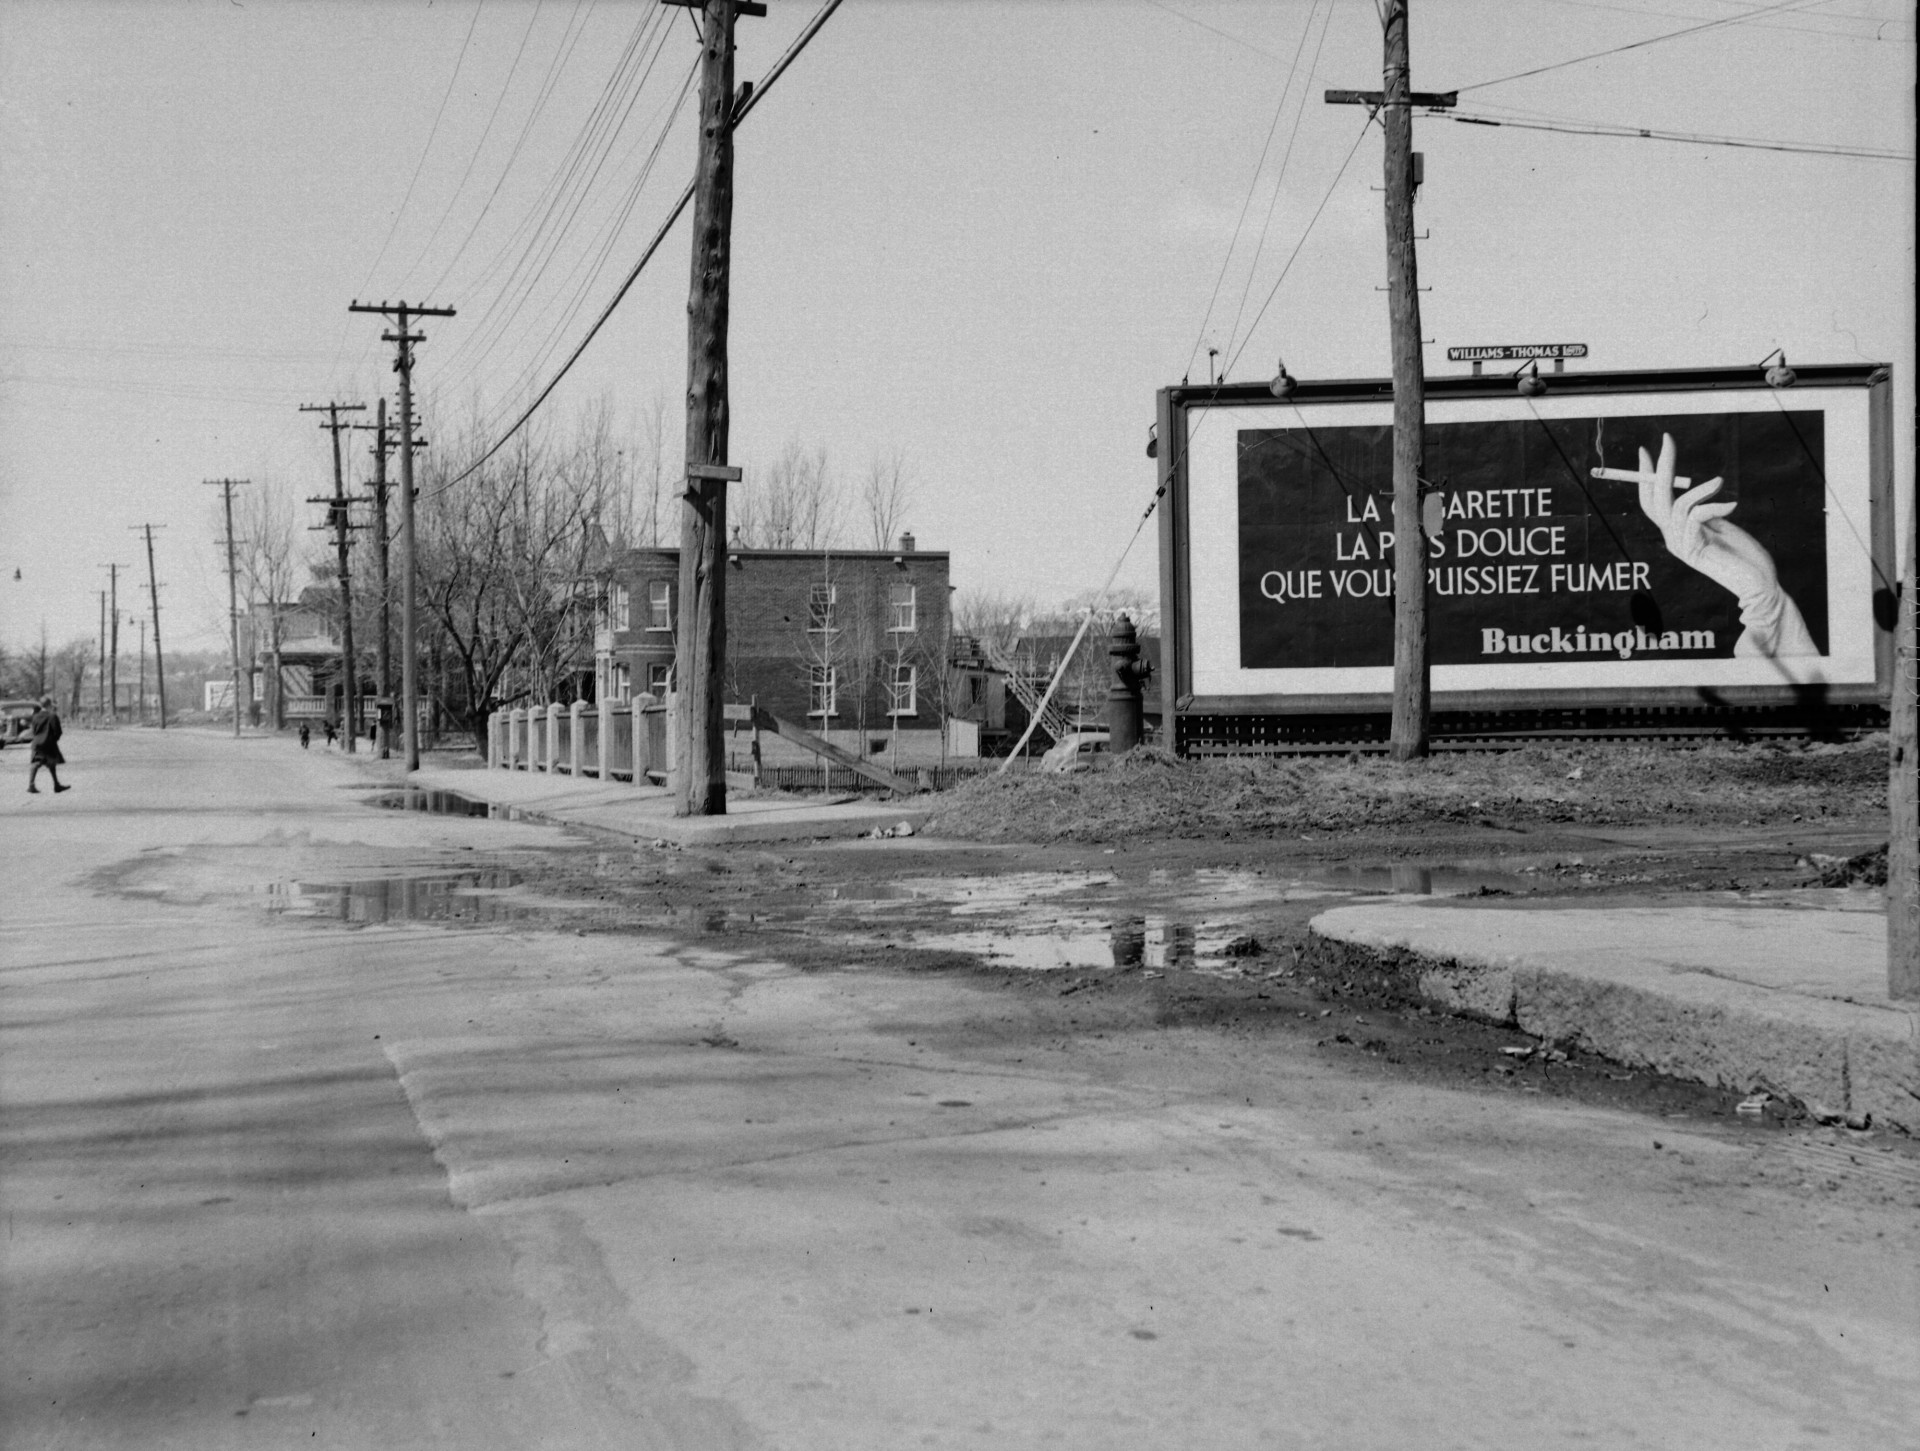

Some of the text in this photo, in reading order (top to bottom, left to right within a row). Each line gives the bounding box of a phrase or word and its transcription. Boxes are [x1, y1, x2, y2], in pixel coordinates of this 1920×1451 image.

[1347, 494, 1381, 523] LA
[1336, 526, 1566, 561] LA PS DOUCE
[1260, 570, 1322, 604] QUE
[1329, 568, 1397, 598] VOU
[1551, 562, 1652, 592] FUMER
[1481, 625, 1717, 659] Buckingham
